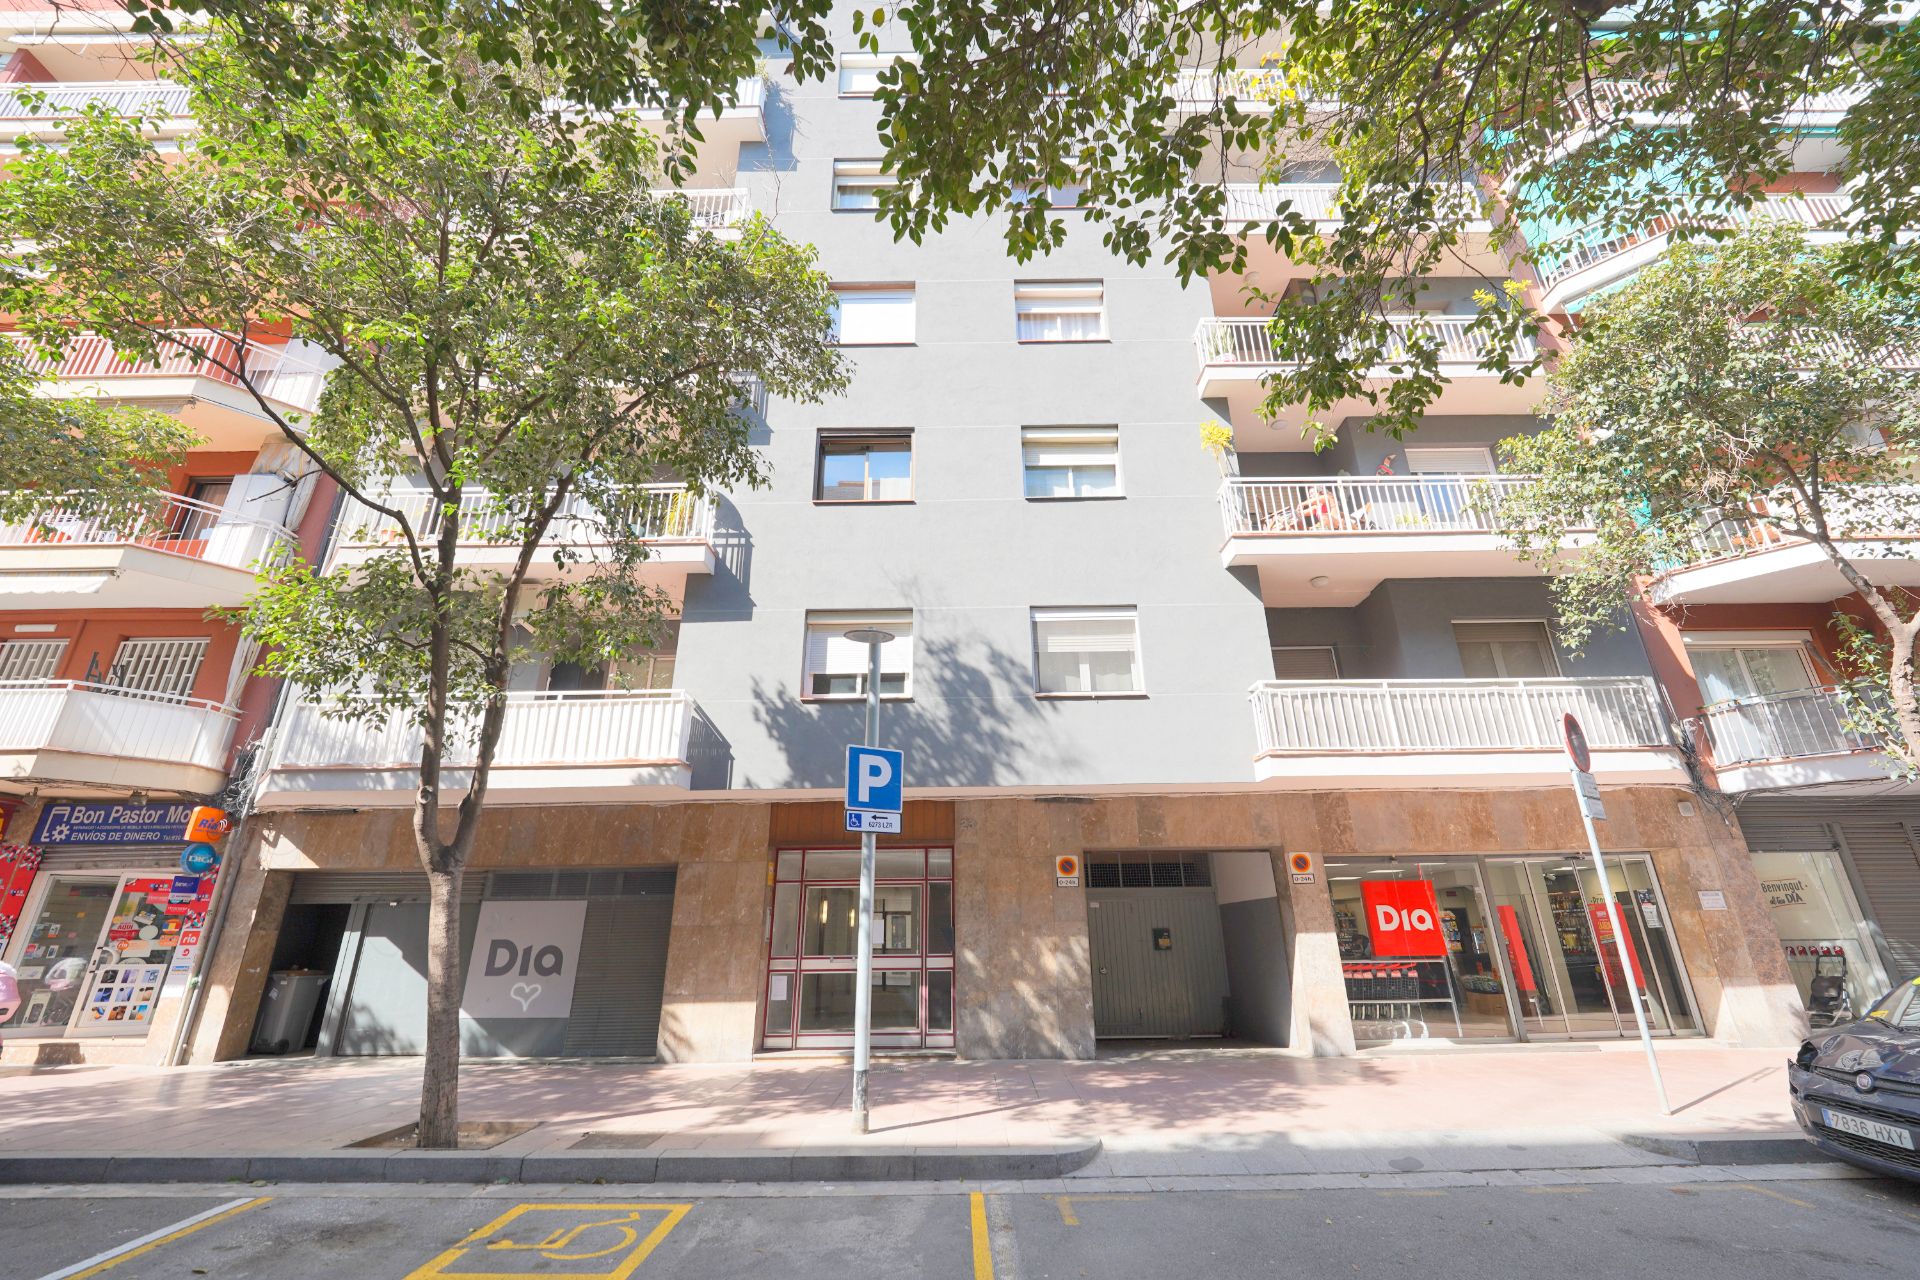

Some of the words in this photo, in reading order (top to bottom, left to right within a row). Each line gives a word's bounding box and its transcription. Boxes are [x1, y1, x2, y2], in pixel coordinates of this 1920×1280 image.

[858, 754, 892, 802] P
[71, 806, 104, 823] Bon
[108, 805, 164, 823] Pastor
[70, 831, 107, 841] ENVÍOS
[108, 832, 123, 841] DE
[123, 831, 160, 841] DINERO
[1761, 881, 1804, 893] Benvingut
[182, 934, 197, 944] ria
[1831, 1113, 1869, 1136] 7836
[1873, 1125, 1904, 1145] HXY
